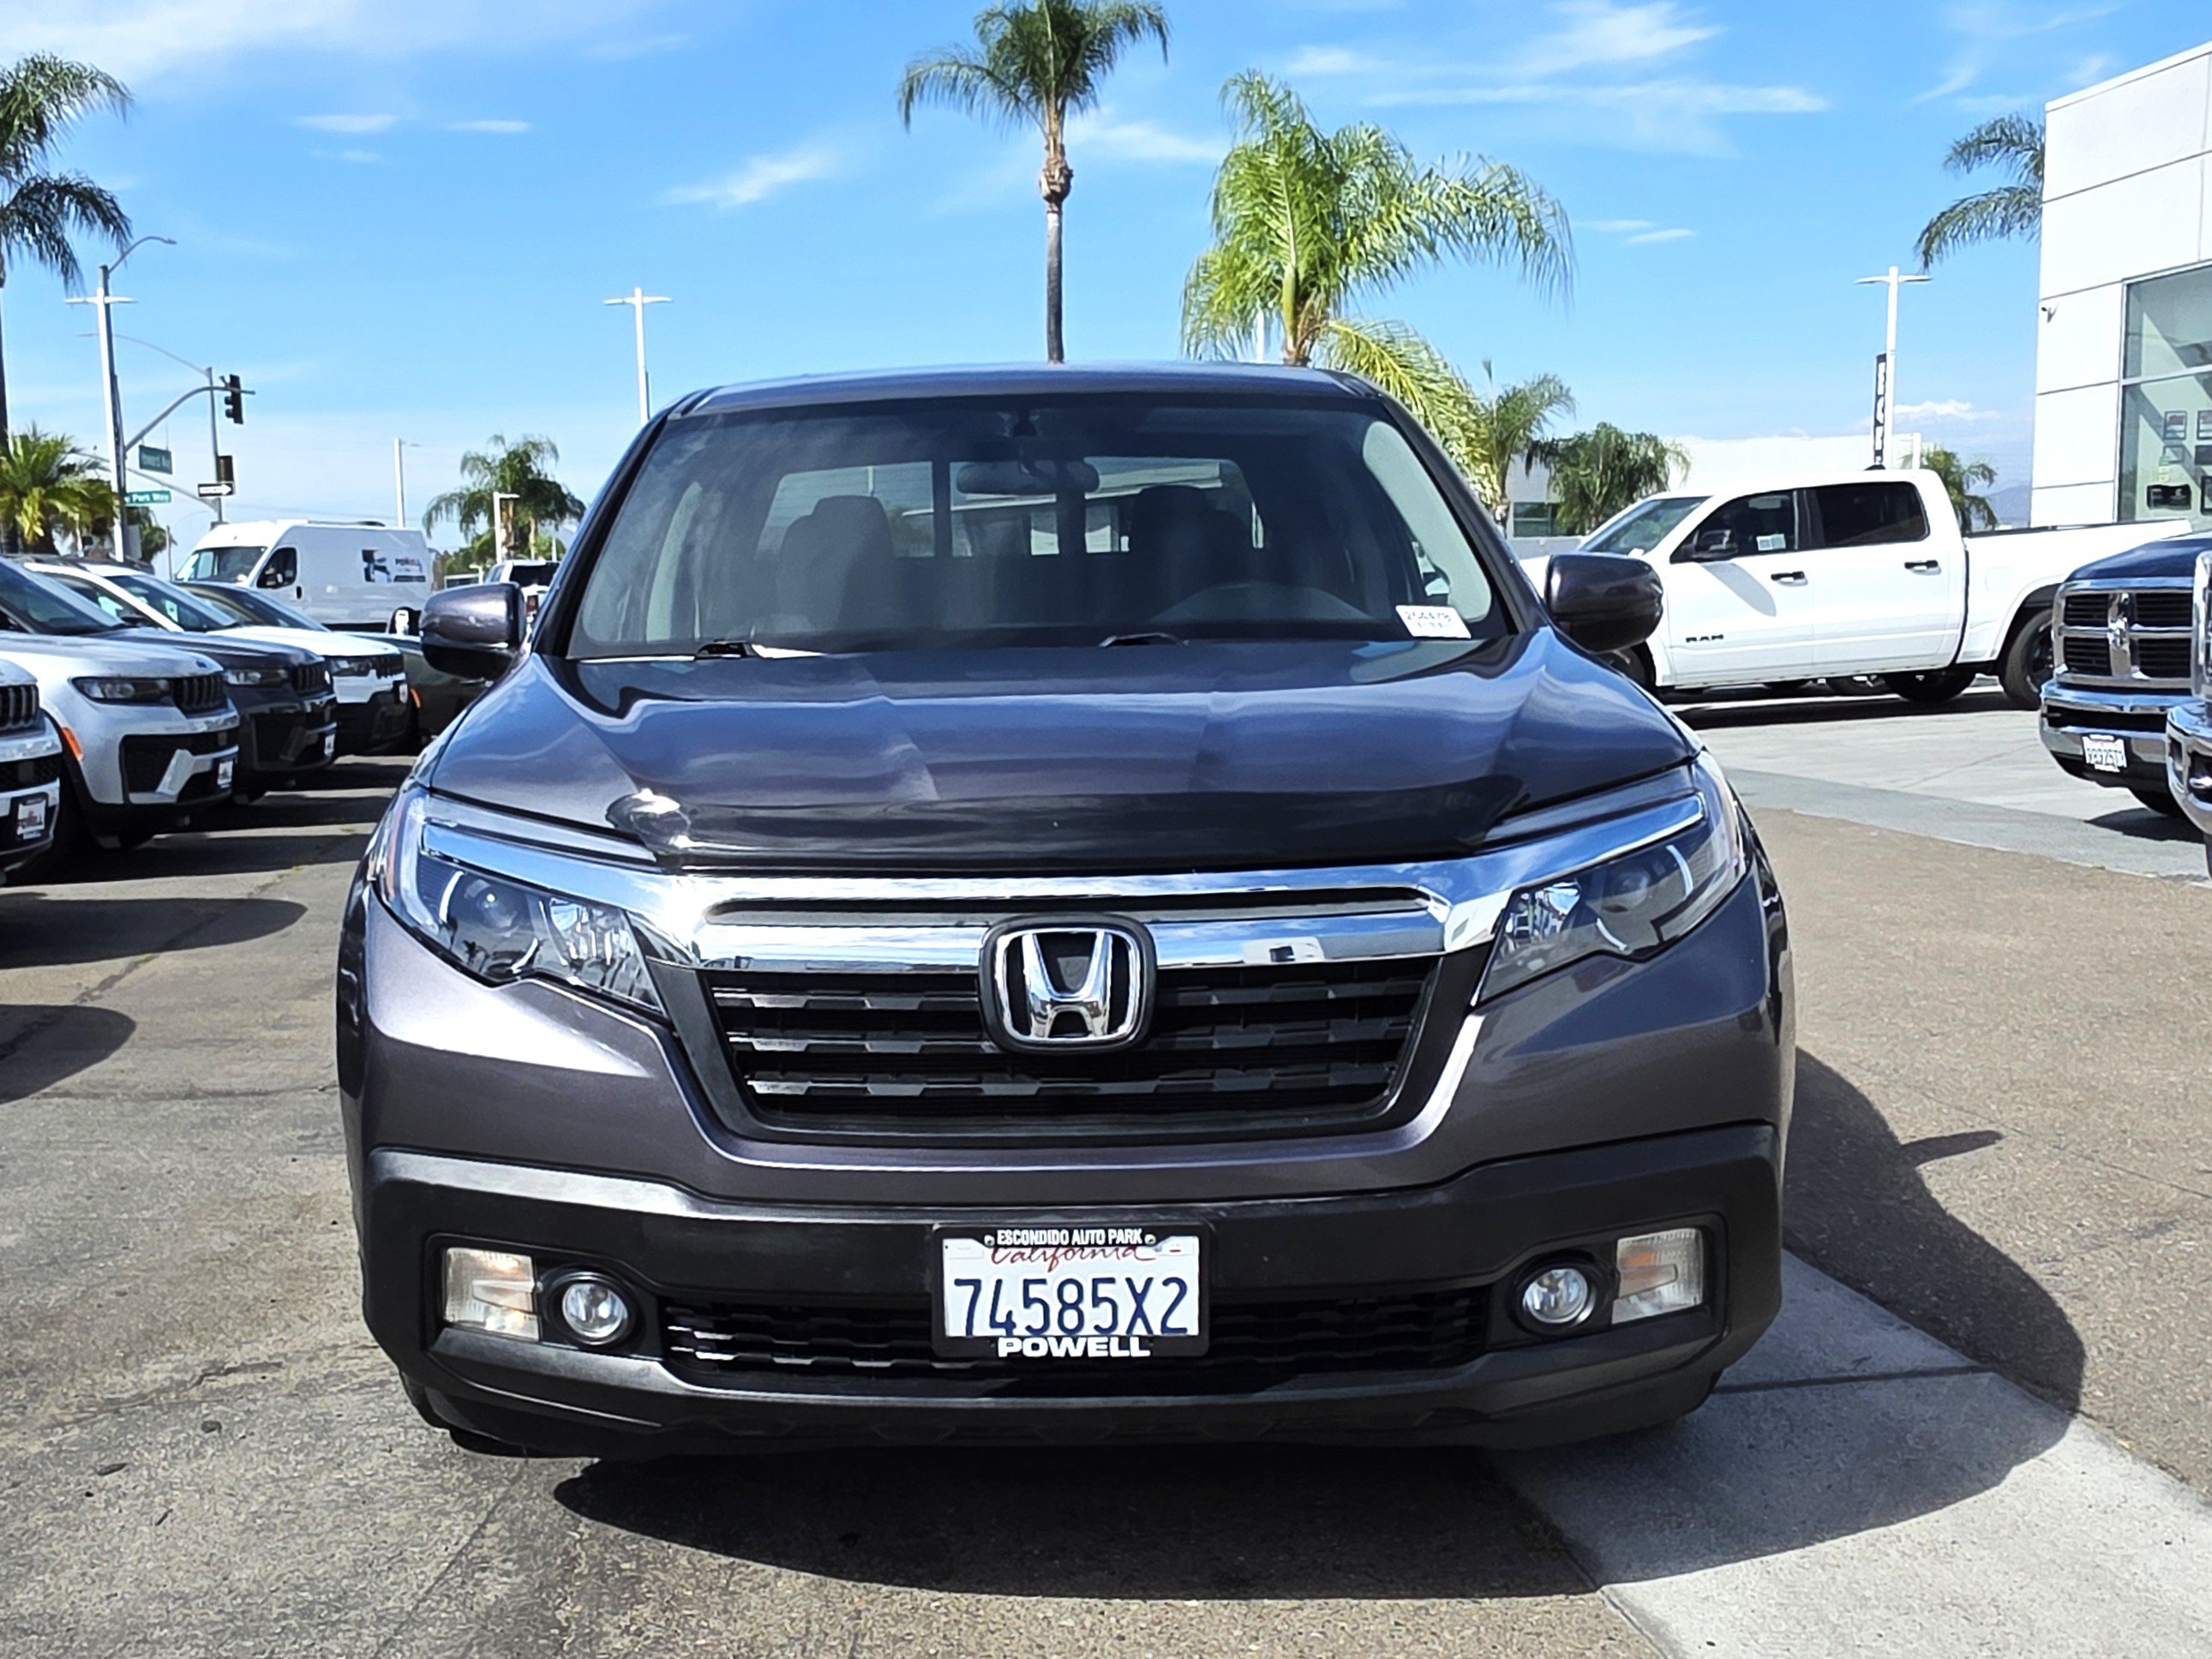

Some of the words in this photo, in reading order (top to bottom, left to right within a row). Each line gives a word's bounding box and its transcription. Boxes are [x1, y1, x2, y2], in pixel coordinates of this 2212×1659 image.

[1685, 633, 1724, 644] RAM
[997, 1229, 1070, 1246] ESCONDIDO
[1071, 1229, 1106, 1245] AUTO
[1107, 1228, 1142, 1245] PARK
[991, 1246, 1156, 1273] California
[954, 1277, 1189, 1336] 74585X2
[998, 1336, 1151, 1358] POWELL
